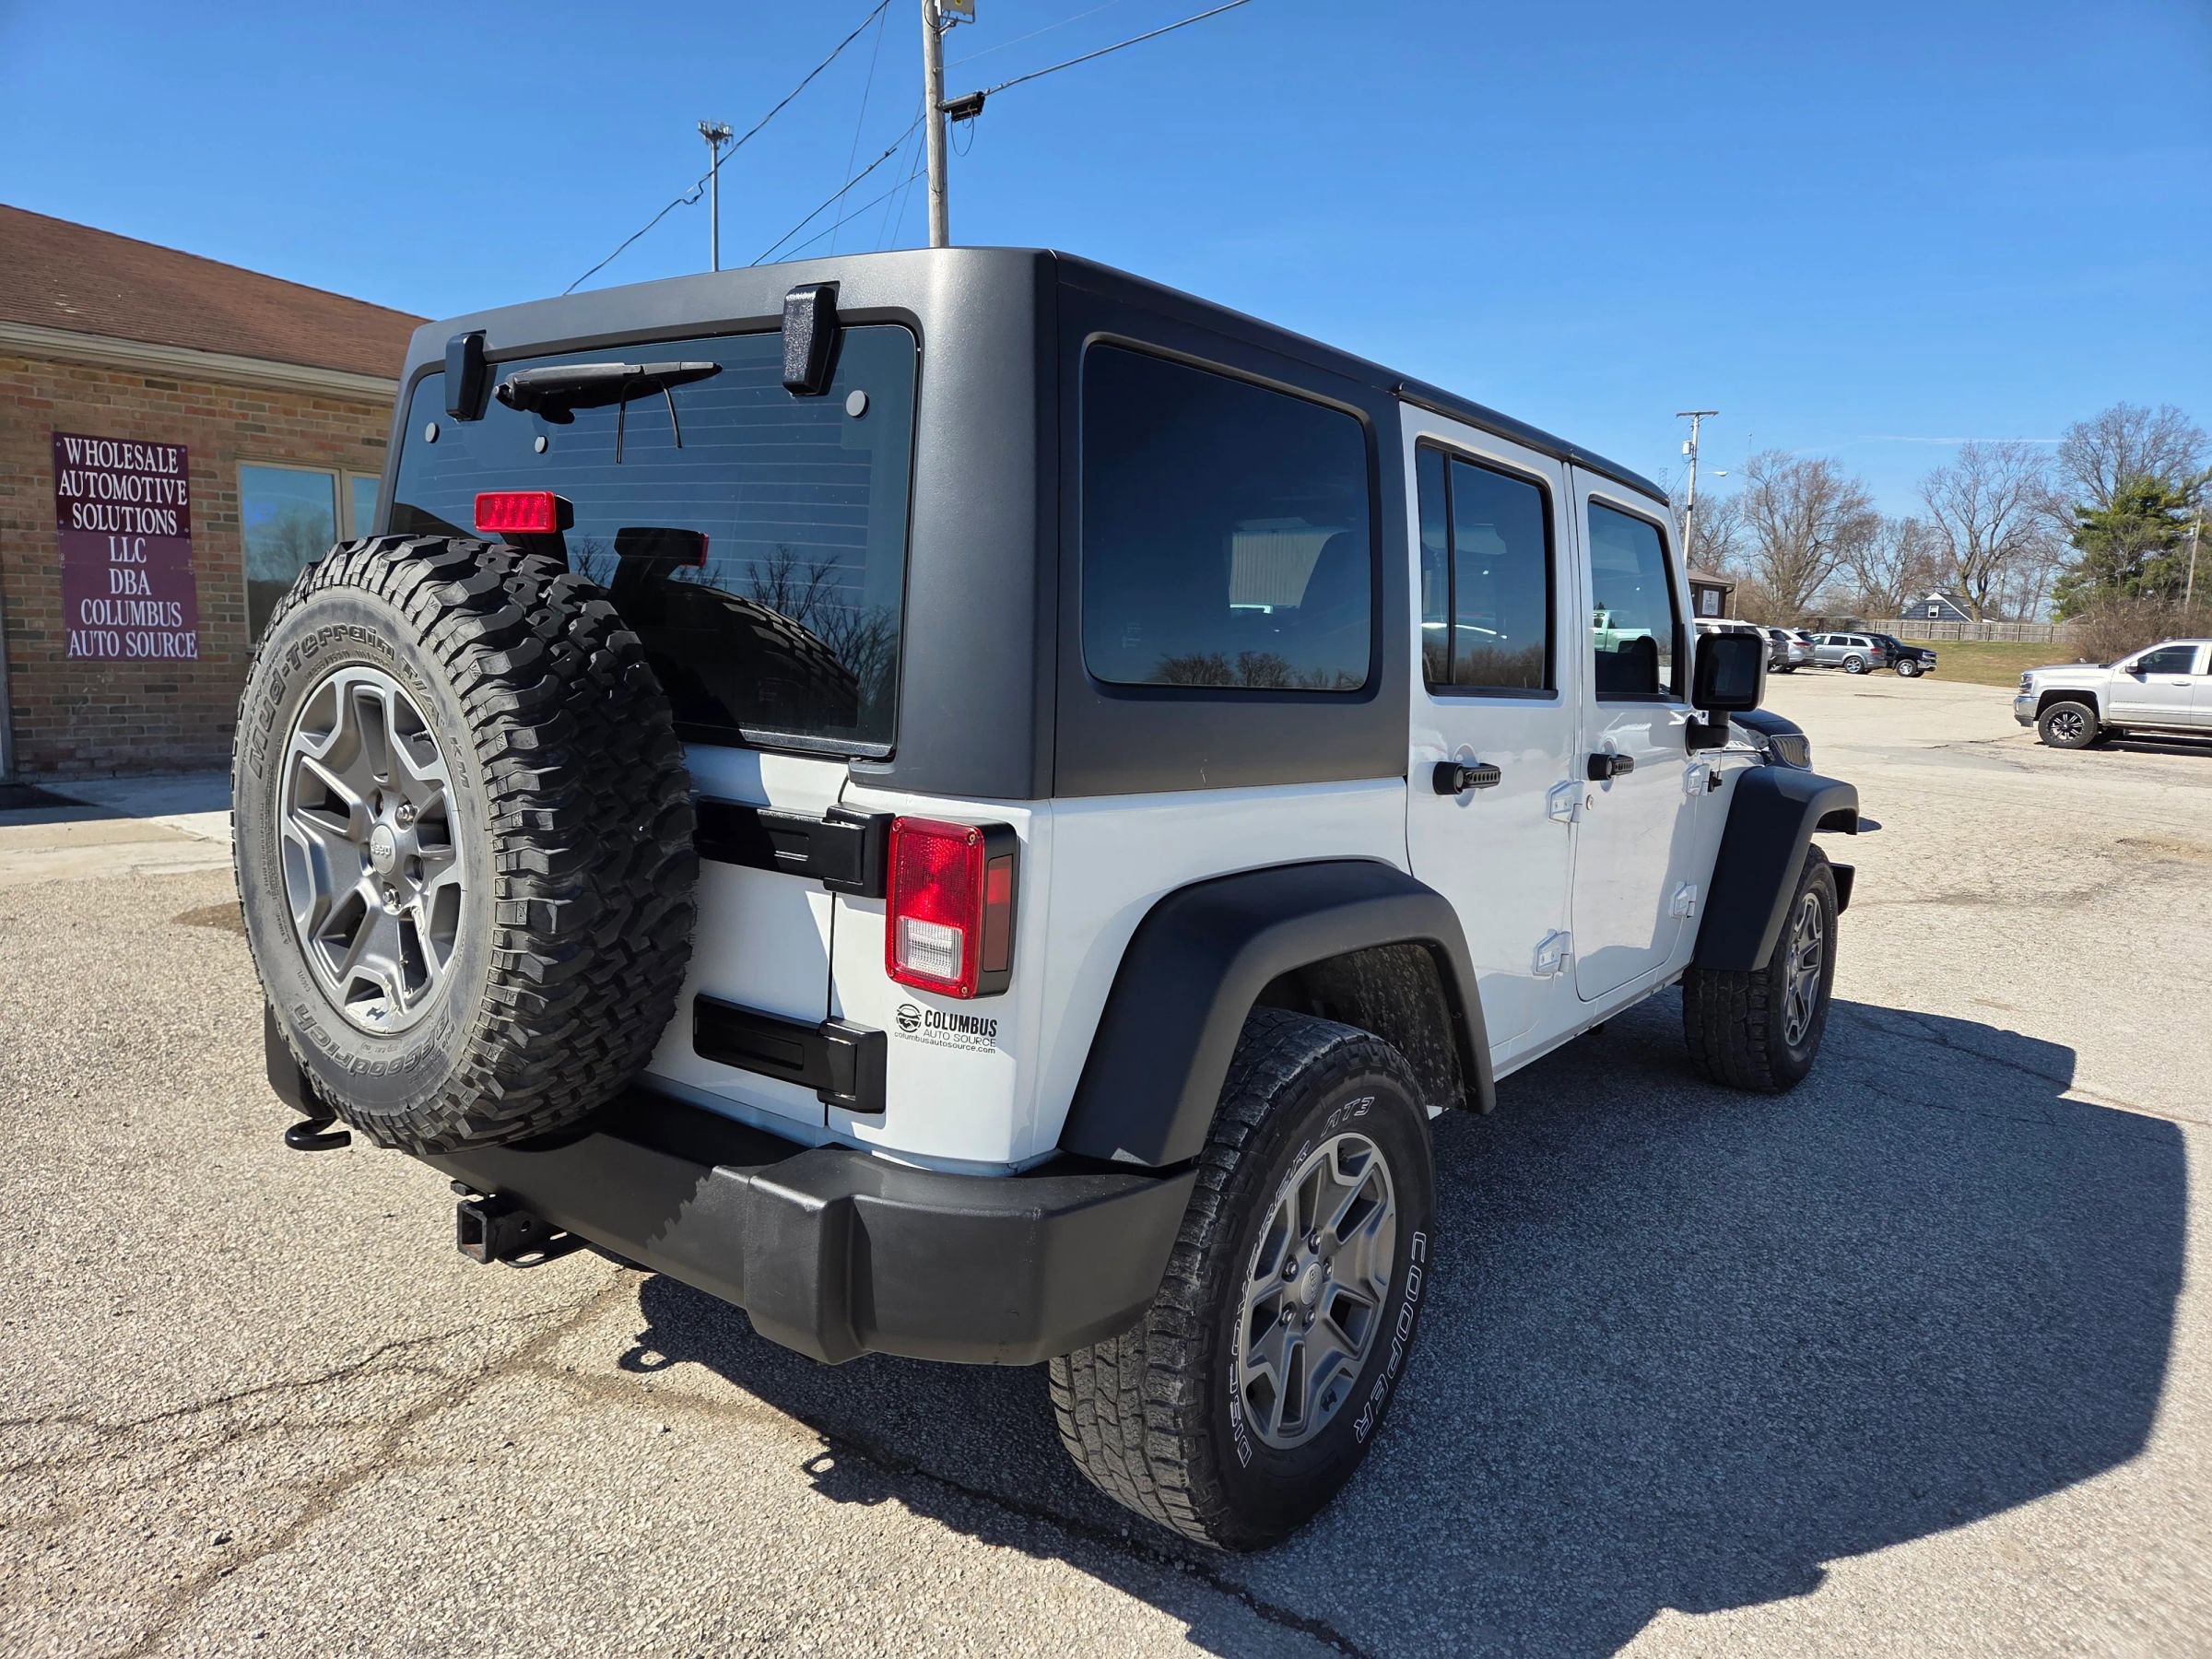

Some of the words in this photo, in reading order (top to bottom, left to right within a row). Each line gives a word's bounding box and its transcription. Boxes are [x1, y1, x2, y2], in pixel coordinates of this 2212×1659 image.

[64, 437, 179, 474] WHOLESALE
[58, 469, 188, 506] AUTOMOTIVE
[72, 502, 178, 536] SOLUTIONS
[109, 535, 147, 563] LLC
[109, 568, 152, 595] DBA
[80, 598, 183, 628] COLUMBUS
[68, 629, 120, 657] AUTO
[125, 631, 198, 659] SOURCE
[923, 1029, 950, 1041] AUTO
[953, 1033, 996, 1048] SOURCE
[924, 1009, 998, 1038] COLUMBUS
[894, 1030, 996, 1054] columbusautosource.com
[1319, 1096, 1375, 1139] AT3
[1354, 1231, 1427, 1444] COOPER
